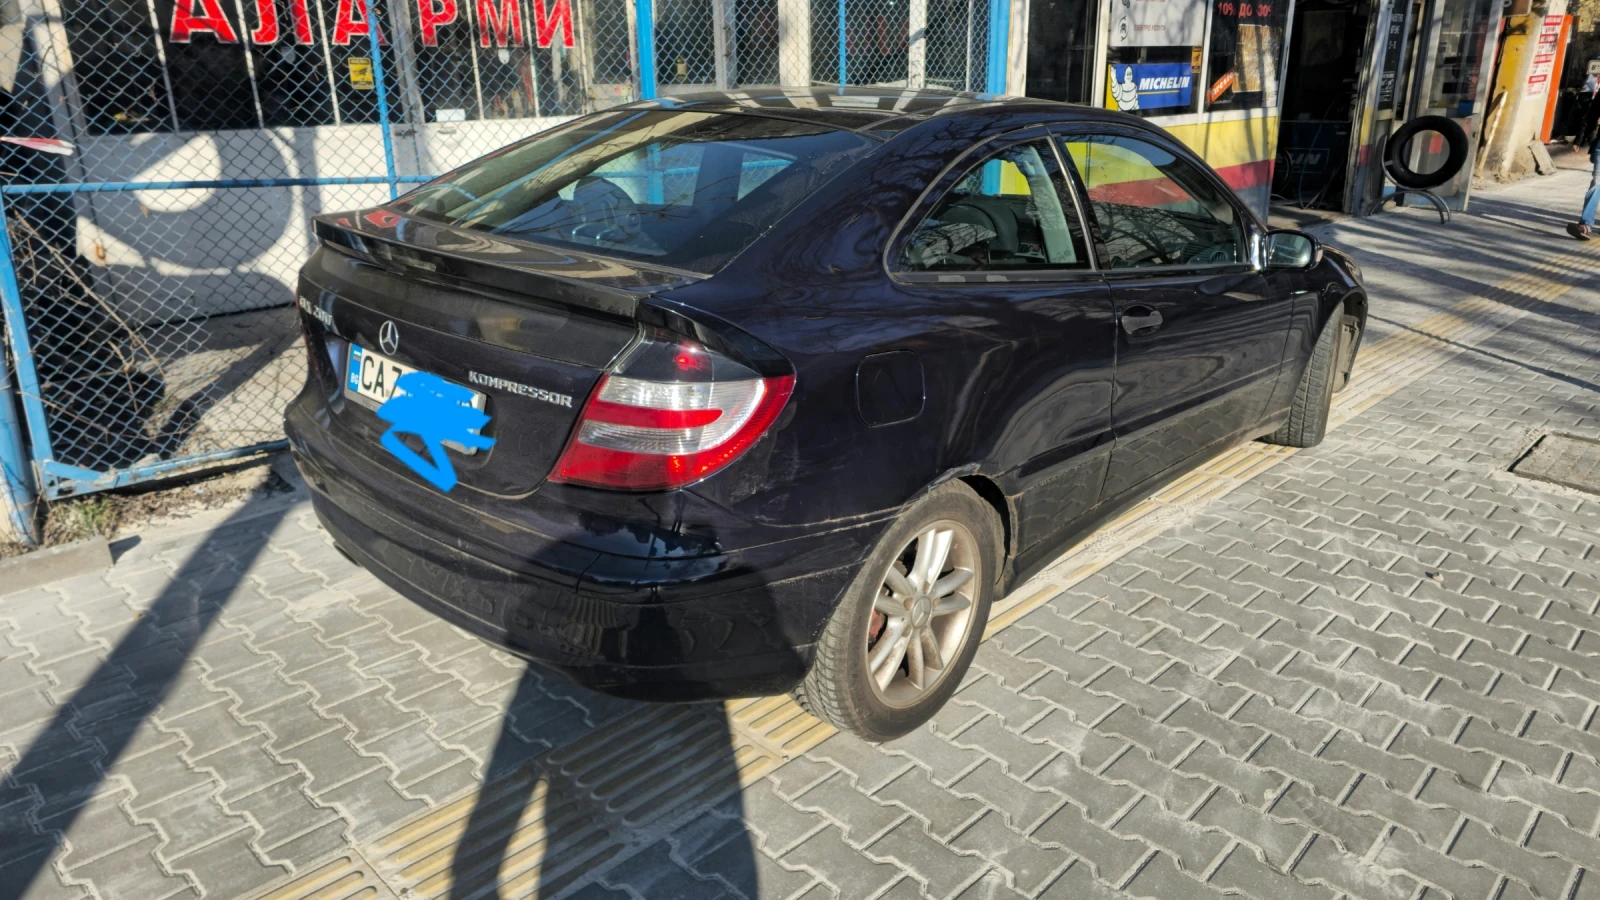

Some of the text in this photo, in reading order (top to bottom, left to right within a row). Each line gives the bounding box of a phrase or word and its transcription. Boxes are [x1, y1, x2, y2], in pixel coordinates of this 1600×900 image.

[1218, 2, 1236, 16] 10%
[1238, 2, 1253, 19] ДО
[1139, 76, 1190, 91] MICHELIN
[350, 372, 359, 385] BG
[468, 370, 572, 408] KOMPRESSOR
